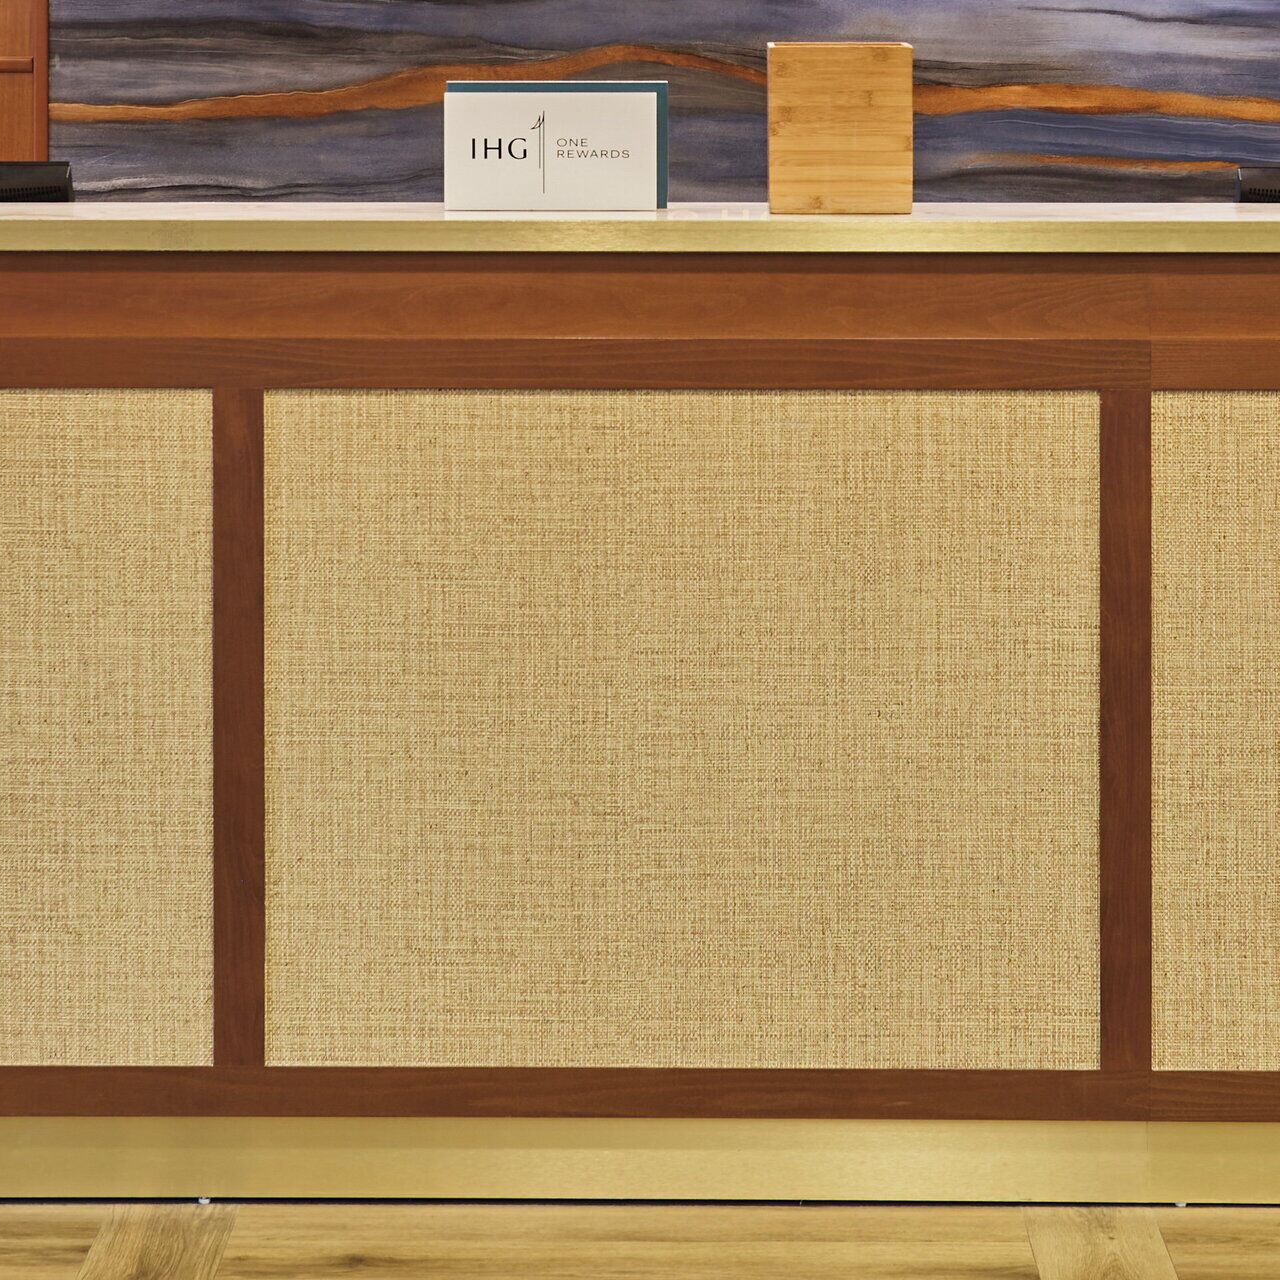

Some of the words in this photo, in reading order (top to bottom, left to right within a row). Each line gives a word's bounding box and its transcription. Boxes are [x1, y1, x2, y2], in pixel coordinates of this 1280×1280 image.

[556, 137, 589, 148] ONE
[470, 137, 528, 161] IHG
[556, 149, 631, 159] REWARDS
